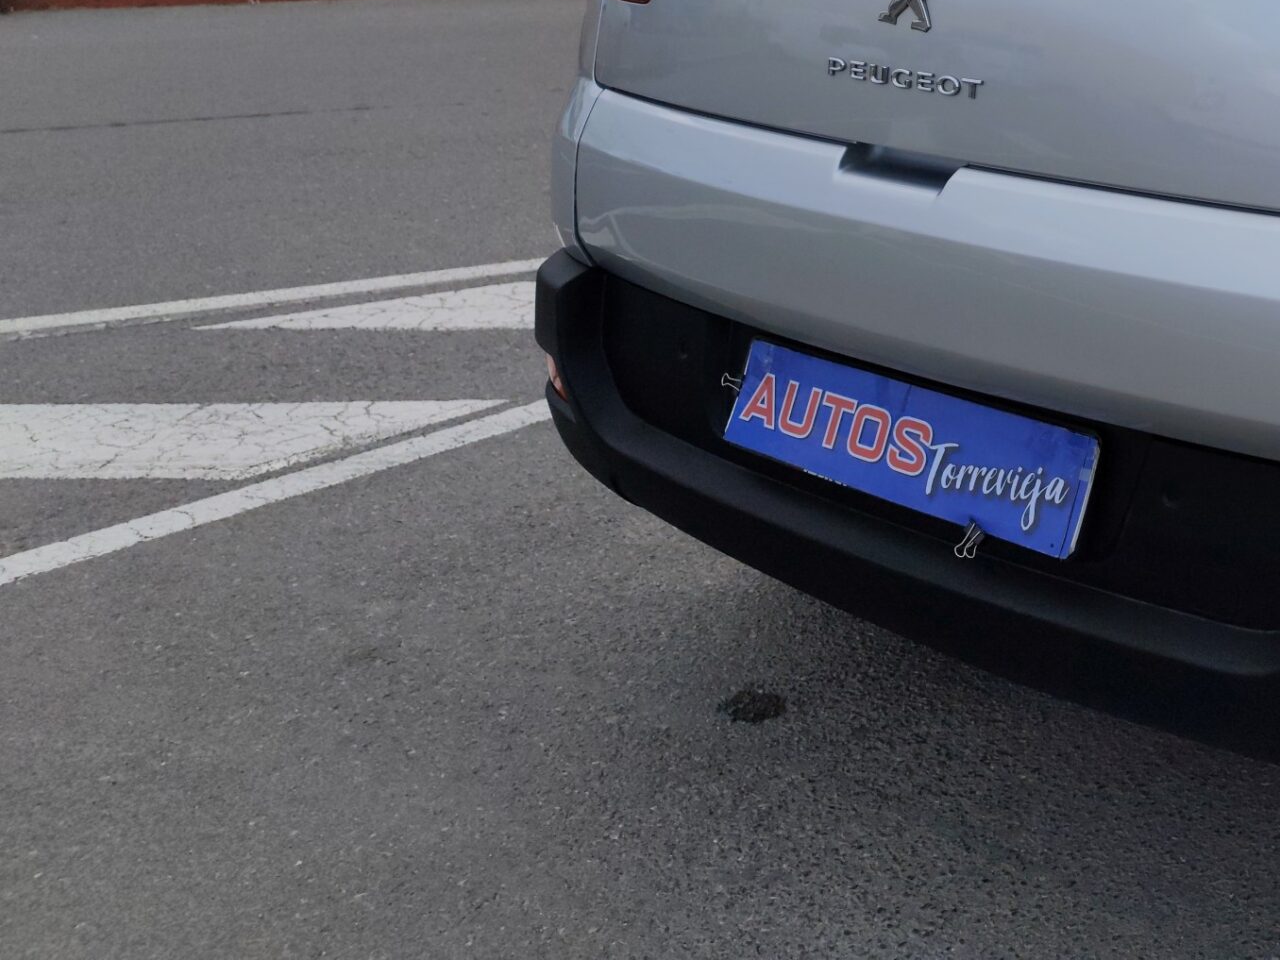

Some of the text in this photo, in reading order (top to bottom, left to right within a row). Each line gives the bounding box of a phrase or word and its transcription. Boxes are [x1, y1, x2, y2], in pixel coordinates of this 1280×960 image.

[828, 56, 985, 100] PEUGEOT
[738, 372, 935, 478] AUTOS
[925, 441, 1071, 532] Torrevieja
